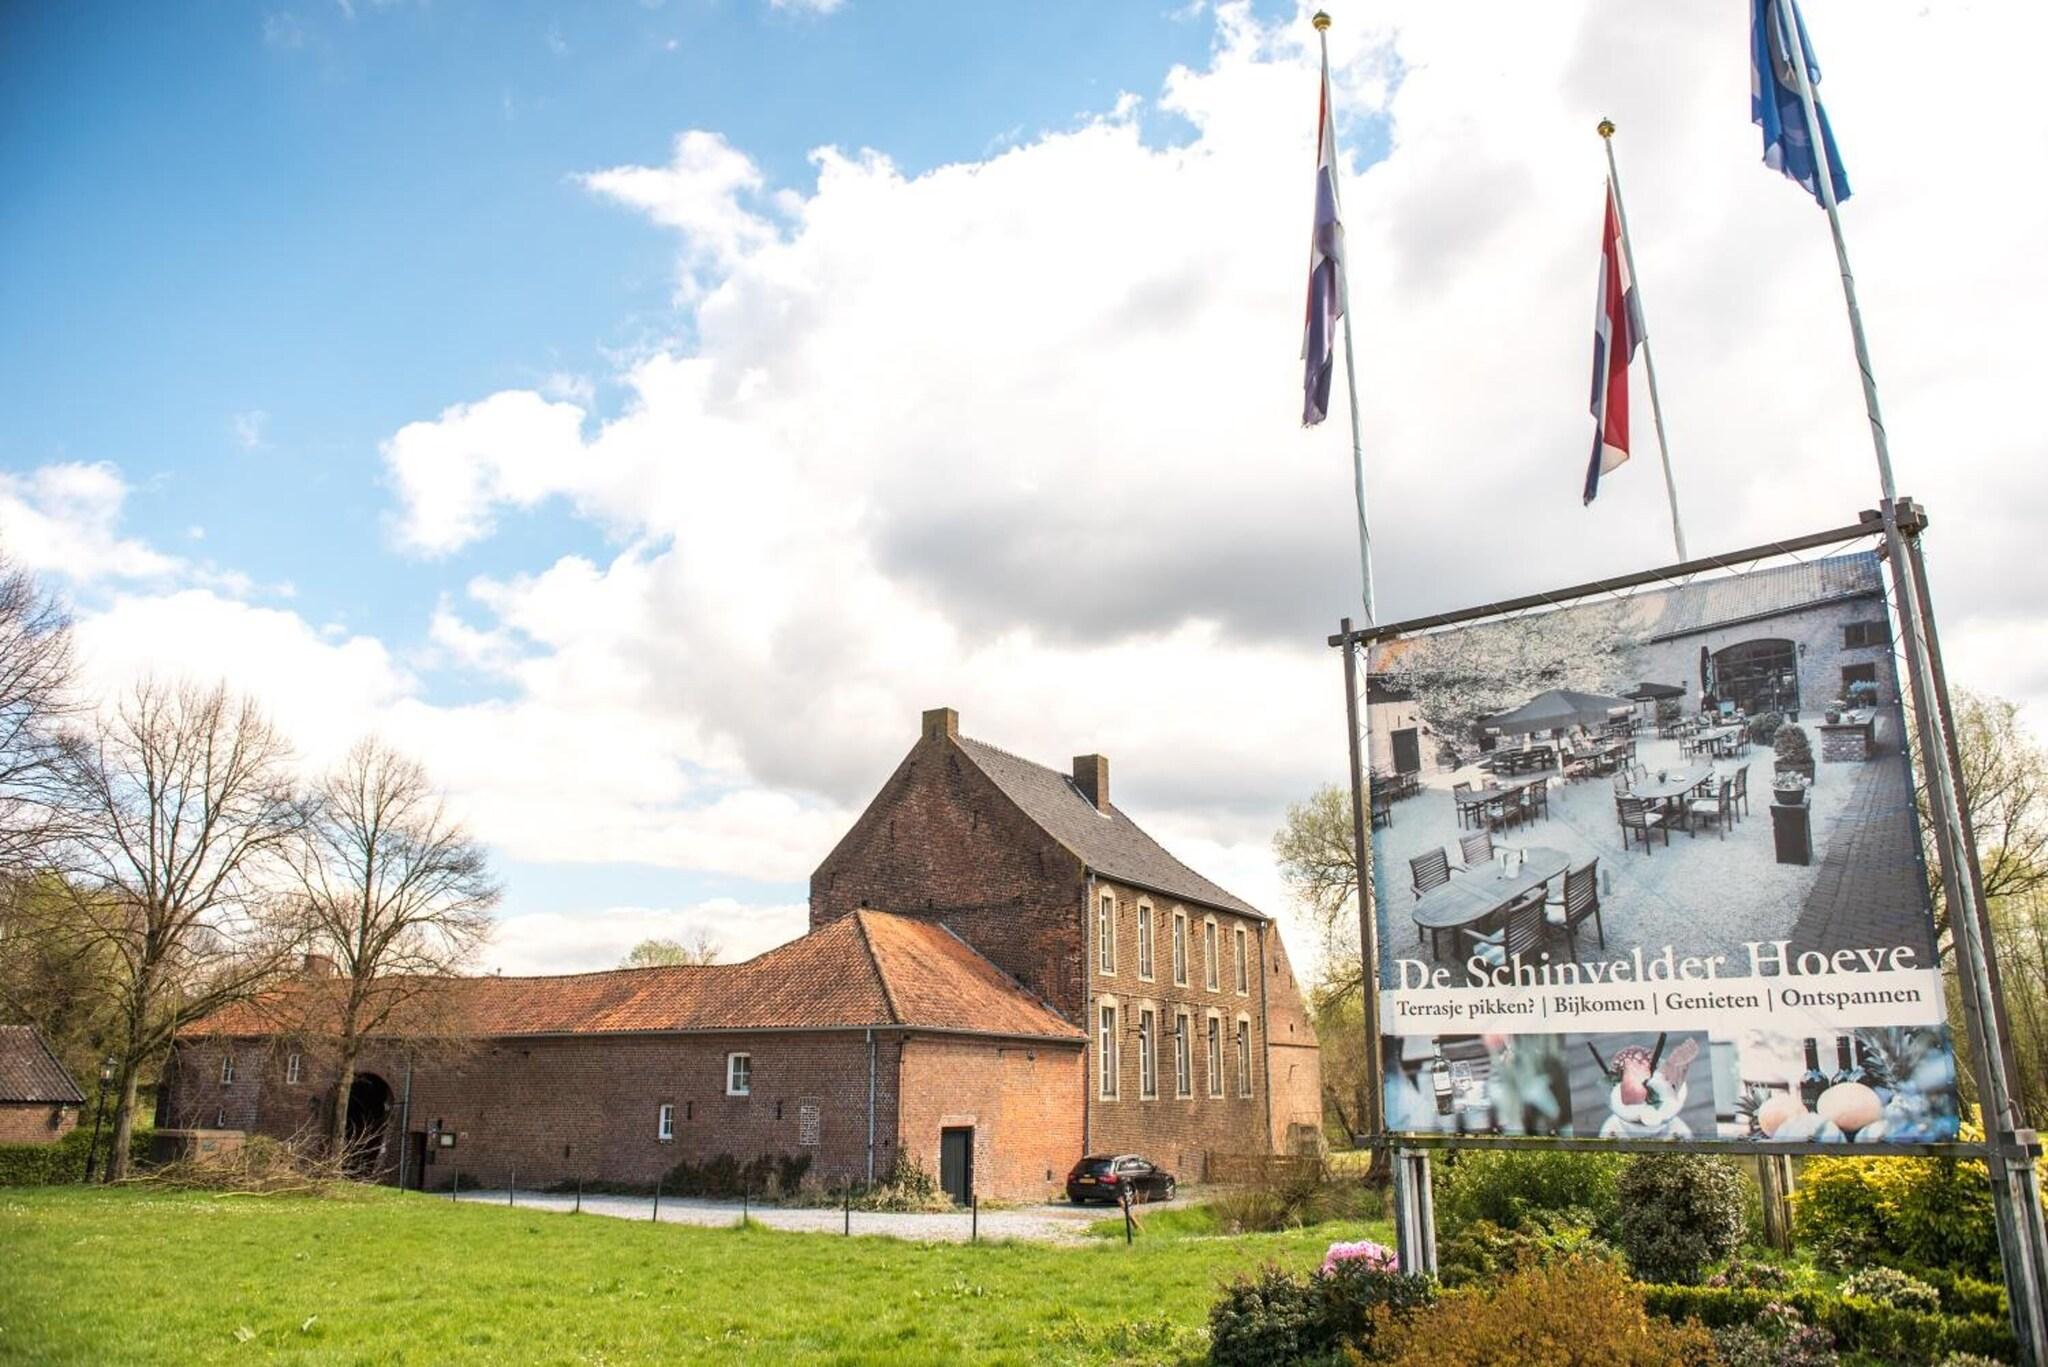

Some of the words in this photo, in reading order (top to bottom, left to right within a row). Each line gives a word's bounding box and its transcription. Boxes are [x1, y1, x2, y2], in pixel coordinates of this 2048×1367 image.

[1394, 957, 1452, 991] De
[1464, 944, 1726, 990] Schinvelder
[1745, 940, 1919, 977] Hoeve
[1396, 998, 1464, 1019] Terrasje
[1468, 998, 1535, 1019] pikken?
[1554, 996, 1646, 1017] Bijkomen
[1665, 991, 1759, 1010] Genieten
[1781, 988, 1921, 1010] Ontspannen
